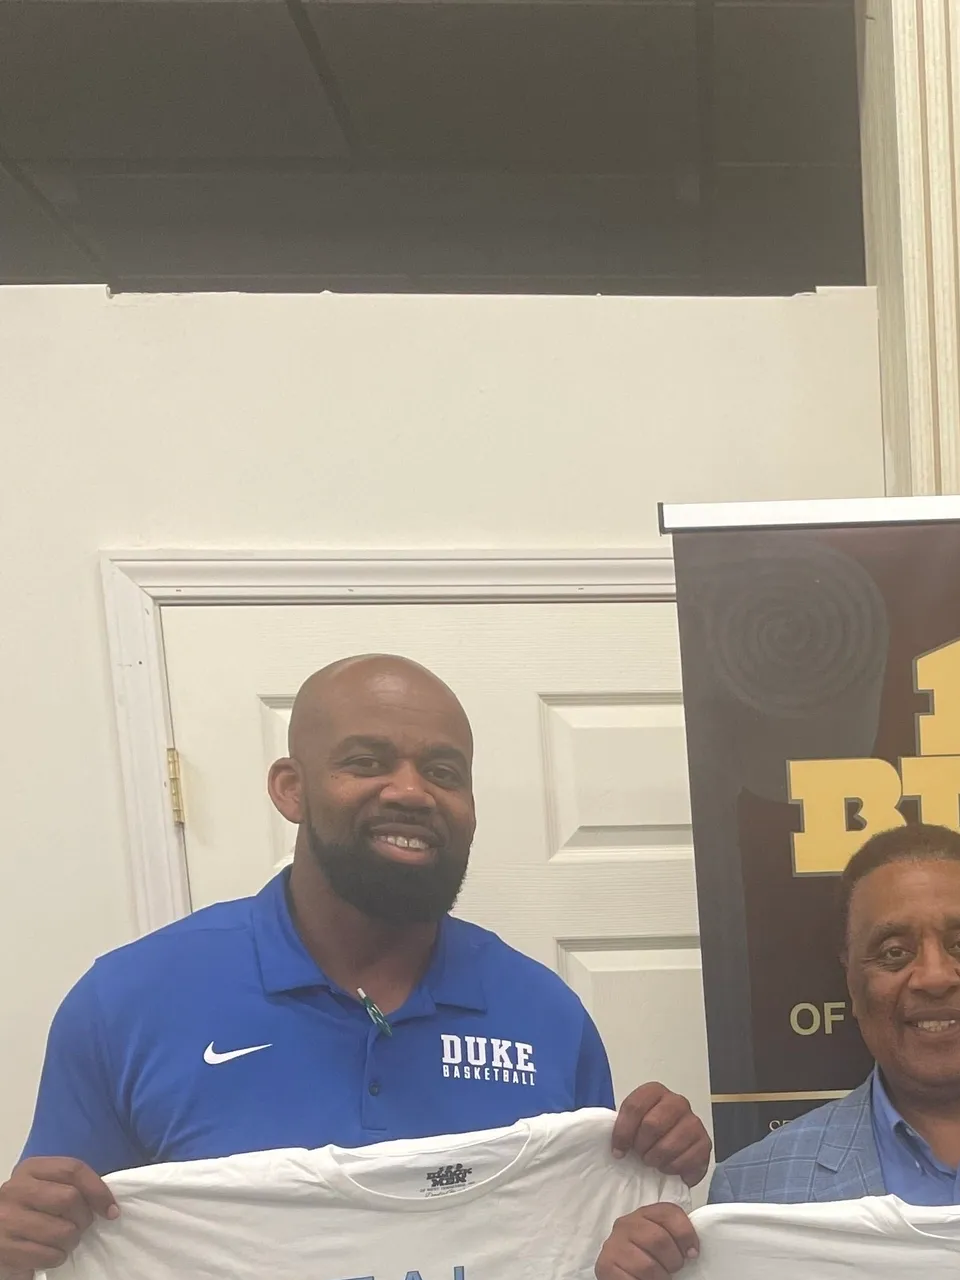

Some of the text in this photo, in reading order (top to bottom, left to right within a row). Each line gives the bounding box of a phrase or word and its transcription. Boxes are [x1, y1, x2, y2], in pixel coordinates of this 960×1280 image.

[789, 1002, 847, 1037] OF
[440, 1034, 537, 1073] DUKE
[442, 1064, 535, 1086] BASKETBALL
